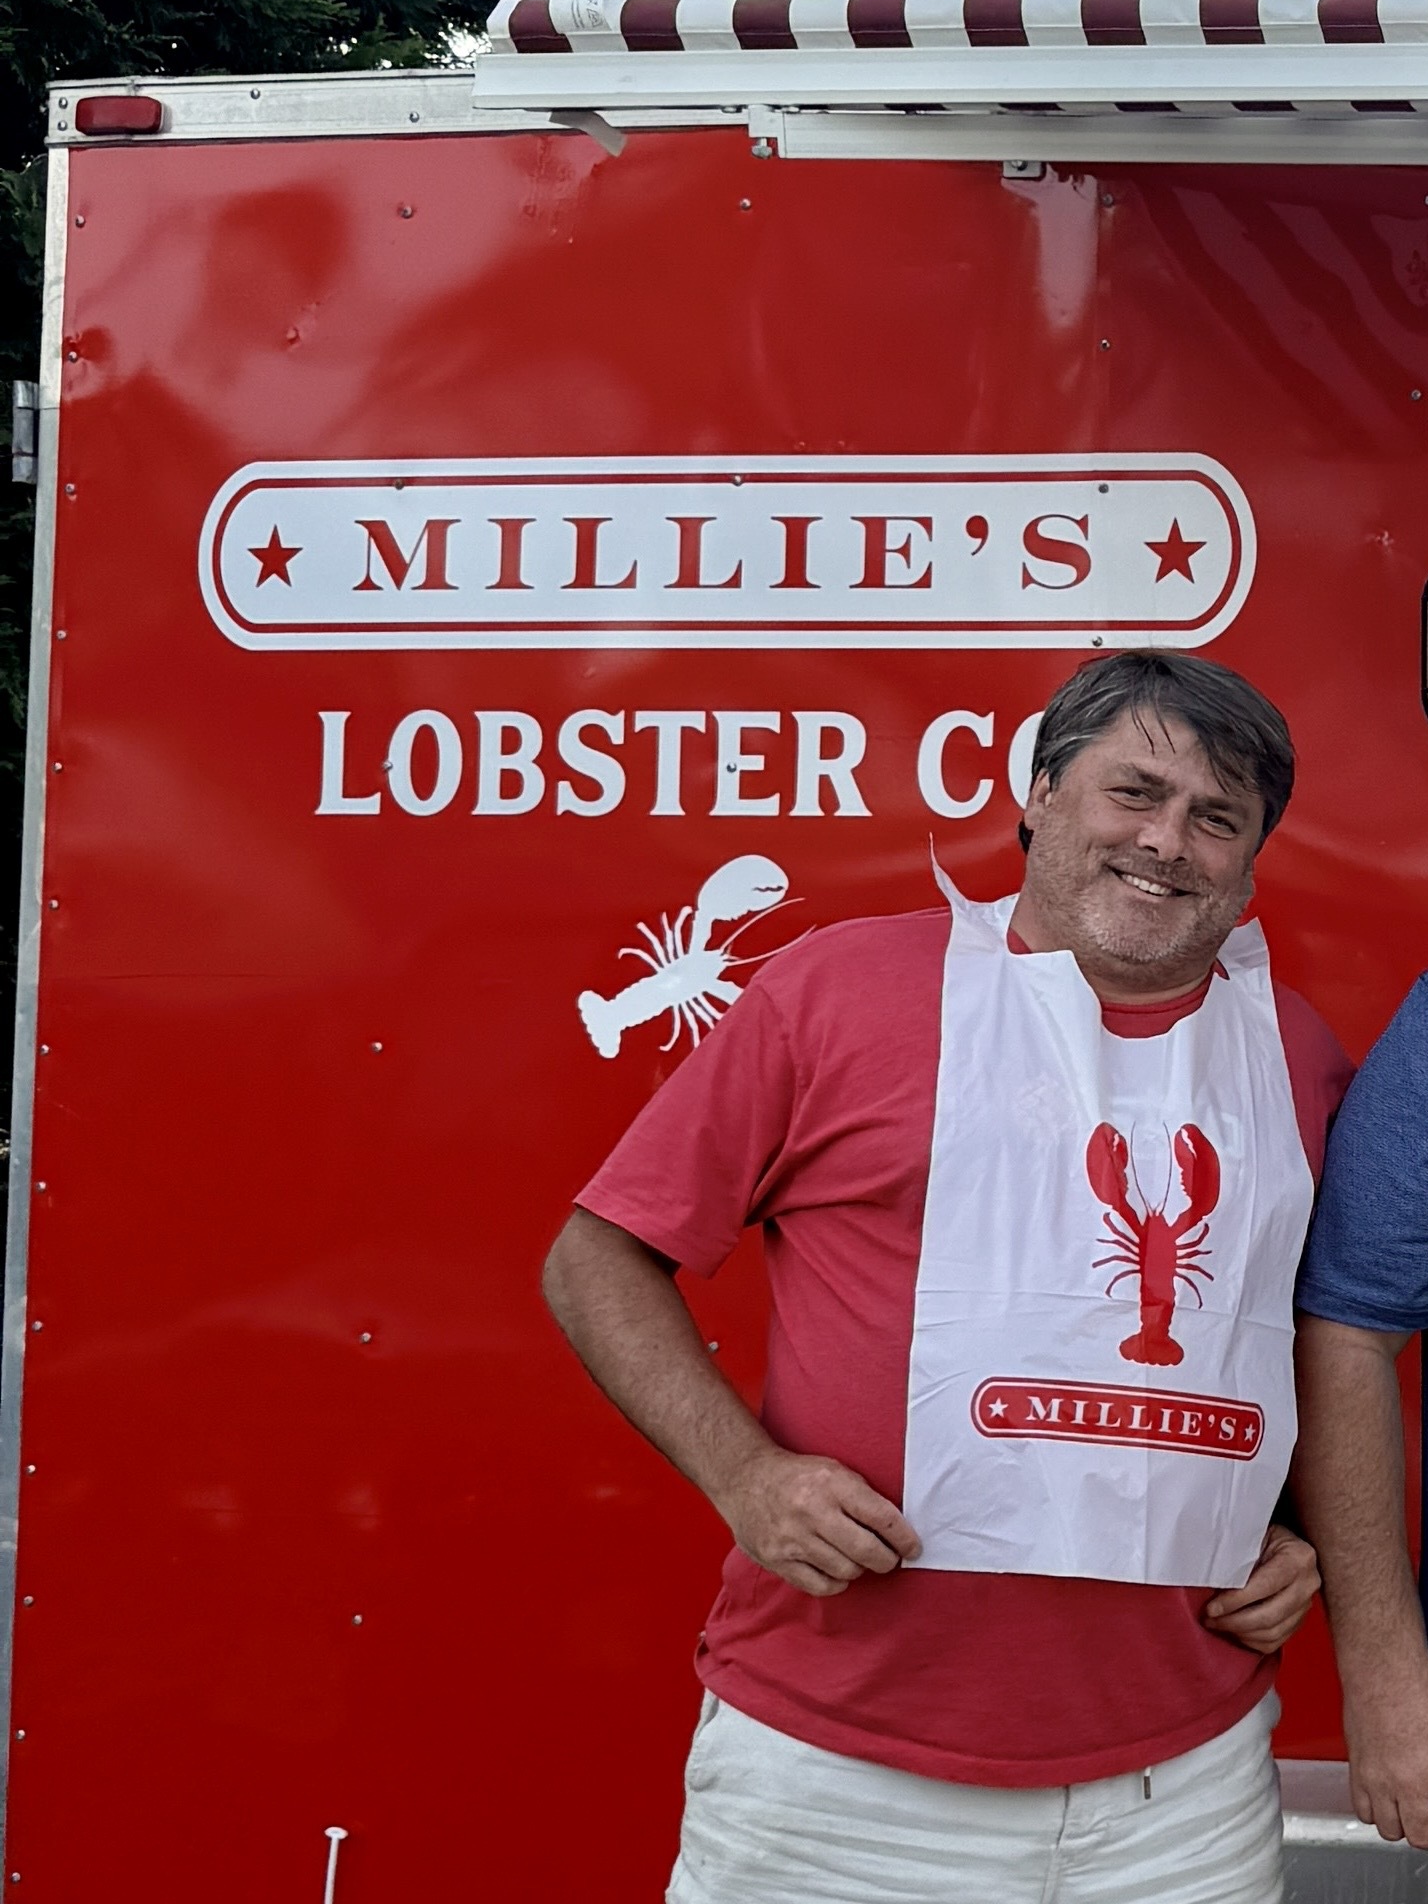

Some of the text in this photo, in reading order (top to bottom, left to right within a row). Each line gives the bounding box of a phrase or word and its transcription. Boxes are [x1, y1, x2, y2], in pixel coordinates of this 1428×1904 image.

[353, 513, 1093, 592] MILLIE'S
[314, 709, 873, 818] LOBSTER
[1025, 1395, 1237, 1441] MILLIE'S
